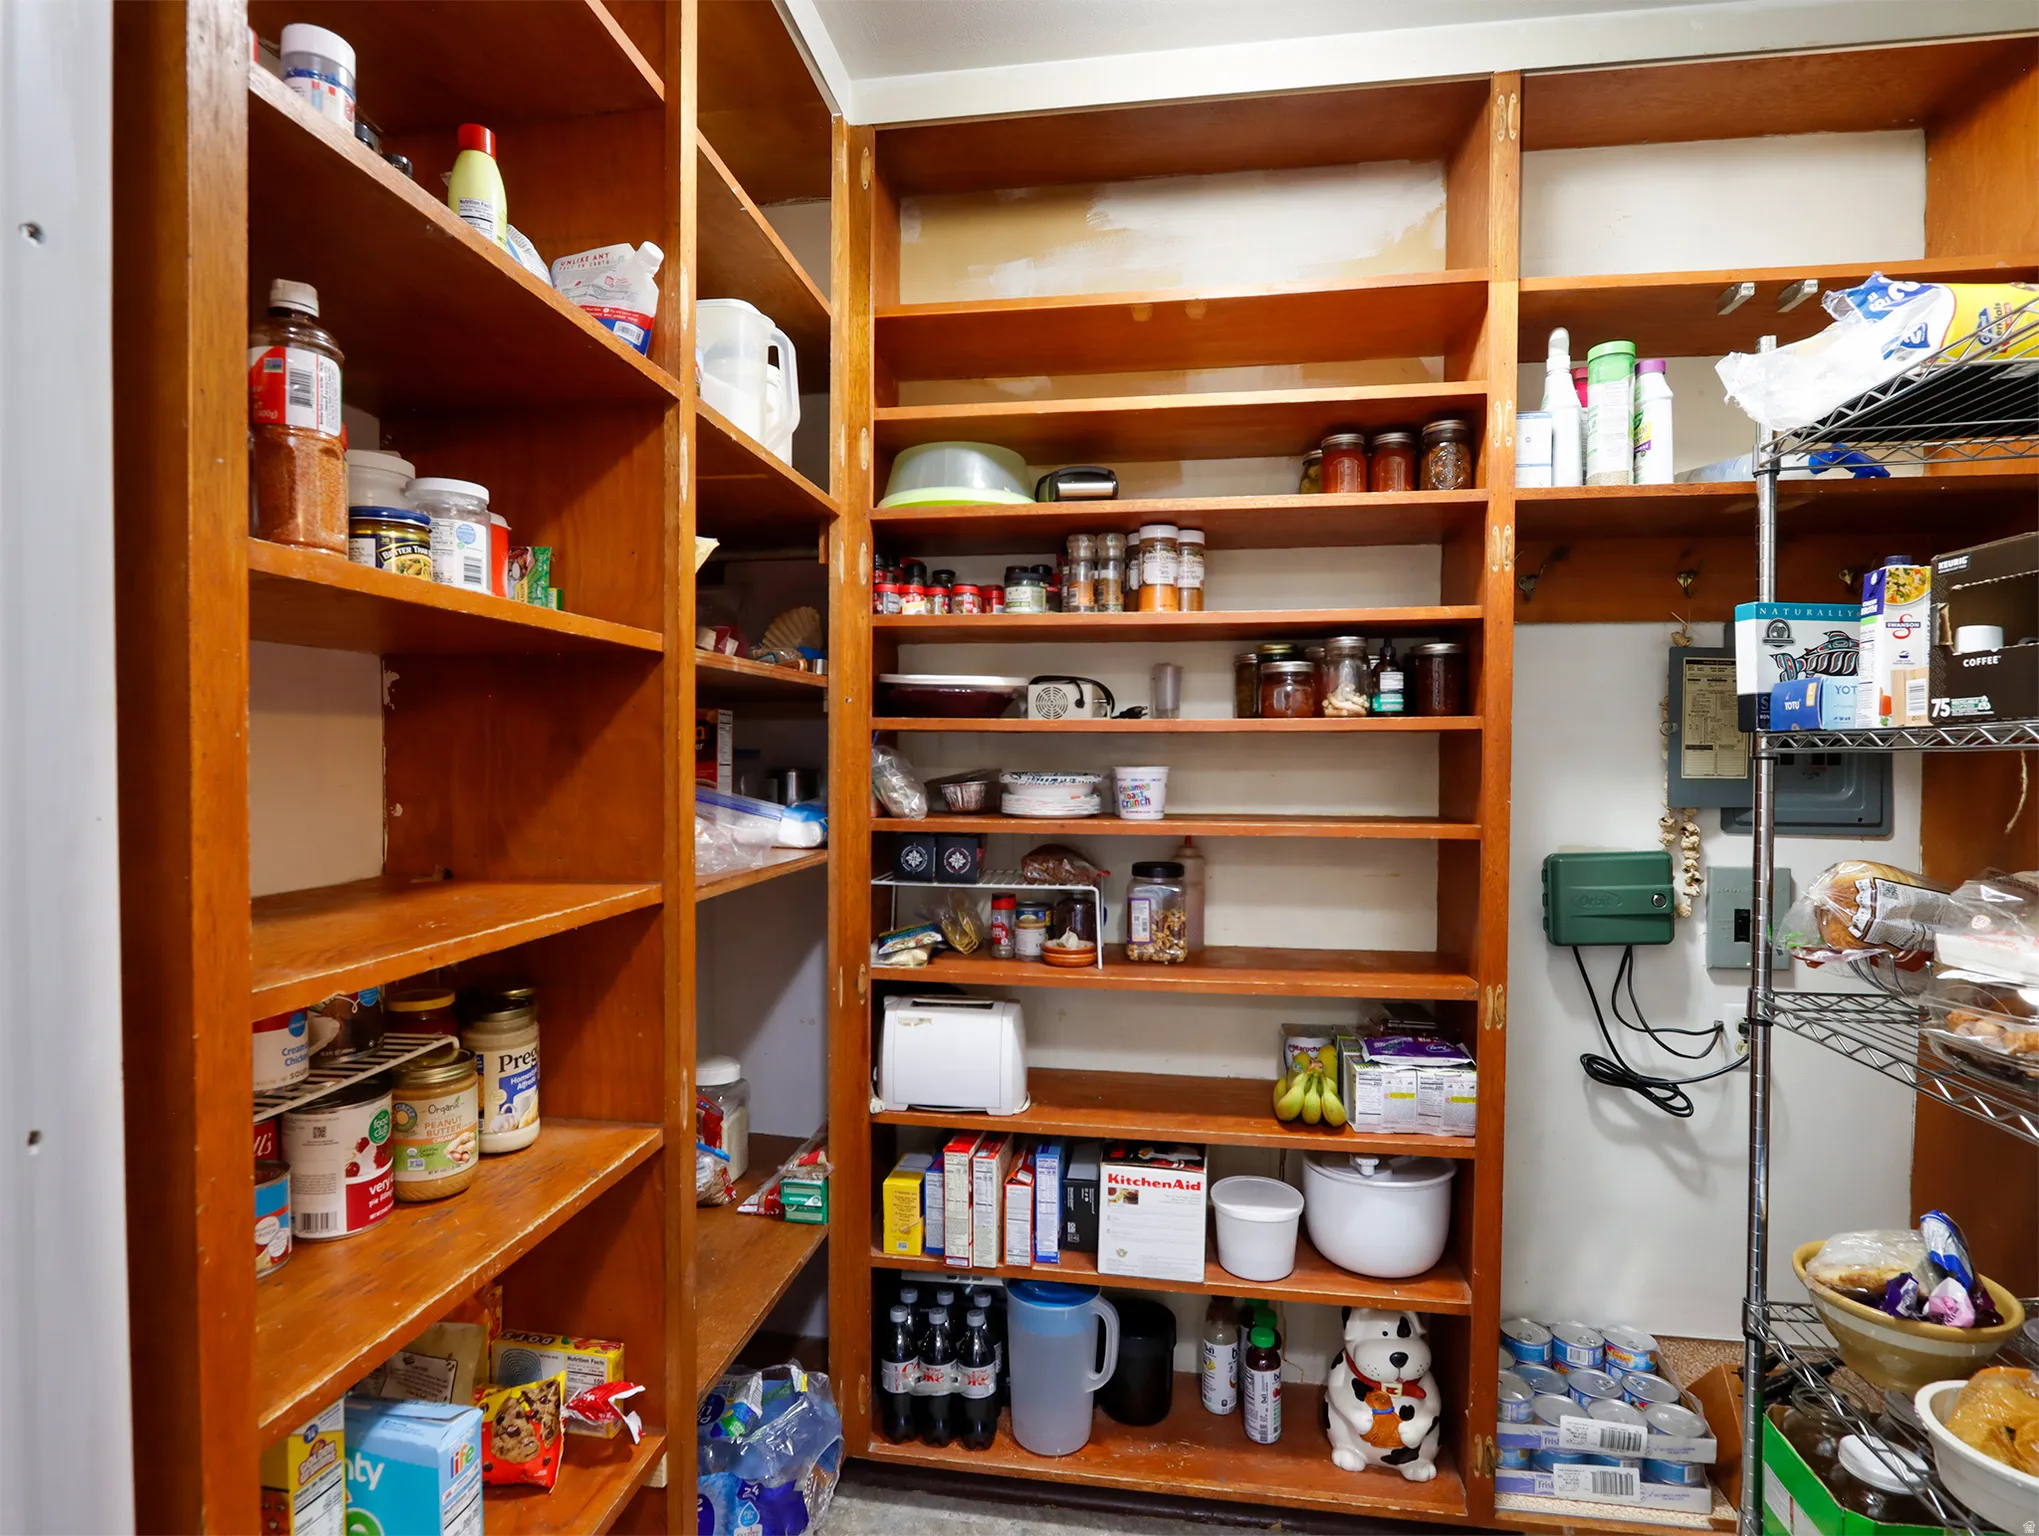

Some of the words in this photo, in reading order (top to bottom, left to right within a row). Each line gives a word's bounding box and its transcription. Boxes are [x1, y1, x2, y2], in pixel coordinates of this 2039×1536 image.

[560, 256, 589, 267] UNLIKE
[592, 252, 610, 261] ANY
[1938, 555, 1970, 570] KEURIG
[1760, 608, 1854, 617] NATURALLY
[1962, 656, 2000, 668] COFFEE
[1834, 685, 1858, 695] YOT
[1784, 701, 1800, 711] YOTU
[1931, 697, 1950, 718] 75
[1122, 796, 1151, 809] Crunch
[498, 1047, 537, 1073] Preg
[428, 1102, 460, 1115] Organic
[374, 1116, 389, 1128] food
[424, 1115, 462, 1129] PEANUT
[374, 1125, 388, 1138] club
[426, 1124, 461, 1137] BUTTER
[369, 1180, 389, 1196] very
[1107, 1172, 1202, 1191] KitchenAid
[450, 1443, 475, 1479] life
[345, 1452, 384, 1491] nty
[744, 1484, 760, 1496] 24
